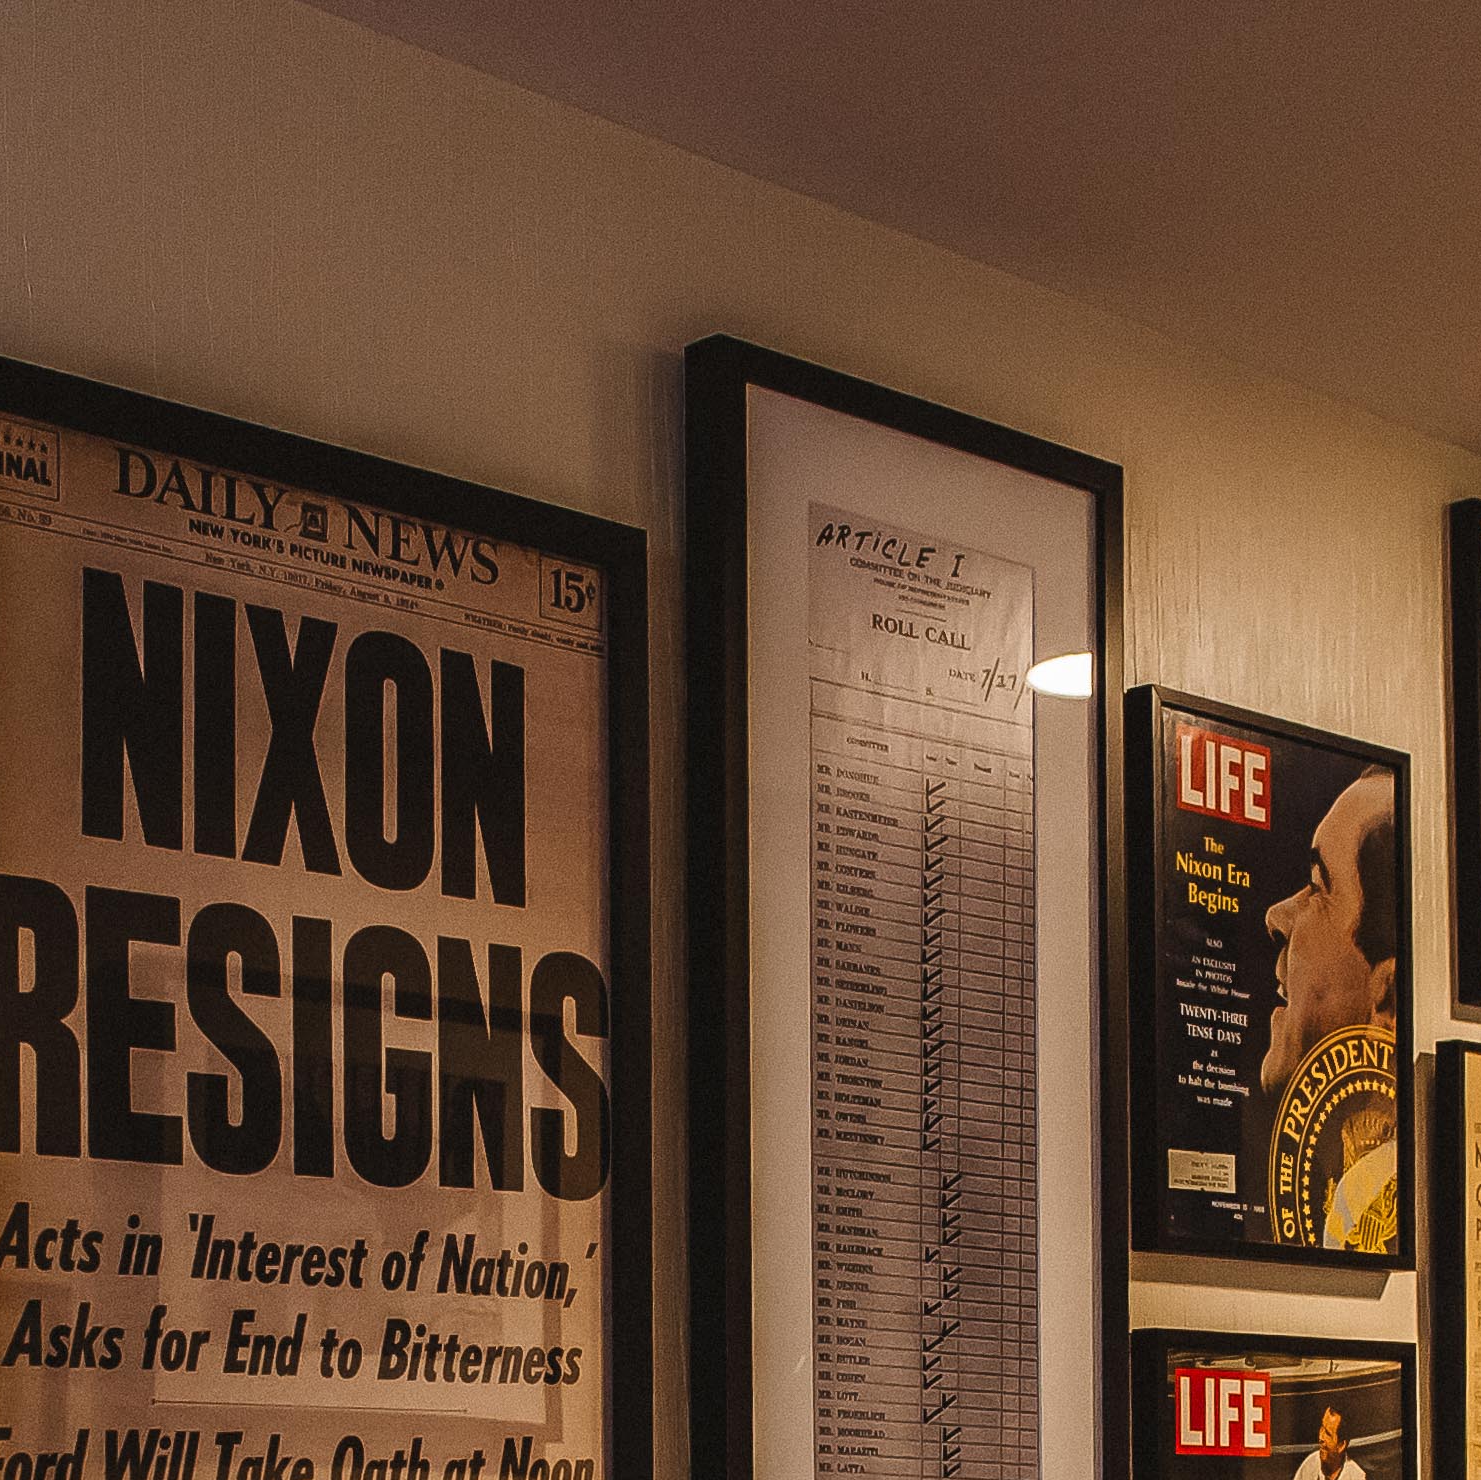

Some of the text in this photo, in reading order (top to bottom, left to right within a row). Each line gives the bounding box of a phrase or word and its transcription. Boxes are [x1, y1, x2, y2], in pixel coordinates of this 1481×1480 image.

[114, 449, 499, 584] DAILY NEWS
[189, 519, 225, 540] NEW
[231, 528, 284, 553] YORK'S
[290, 543, 346, 569] PICTURE
[352, 559, 432, 589] NEWSPAPER
[816, 523, 965, 577] ARTICLE I
[872, 614, 970, 651] ROLL CALL
[81, 566, 526, 908] NIXON
[1181, 735, 1266, 823] LIFE
[1176, 852, 1251, 888] Nixon Era
[1204, 837, 1224, 856] The
[1188, 883, 1239, 913] Begins
[1180, 1003, 1248, 1028] TWENTY-THREE
[1187, 1023, 1241, 1044] TENSE DAYS
[1283, 1039, 1394, 1144] PRESIDENT
[1280, 1152, 1293, 1194] THE
[119, 1213, 163, 1277] in
[189, 1212, 369, 1290] 'Interest
[381, 1230, 430, 1292] of
[0, 1300, 582, 1386] Asks for End to Bitterness
[1179, 1376, 1267, 1449] LIFE
